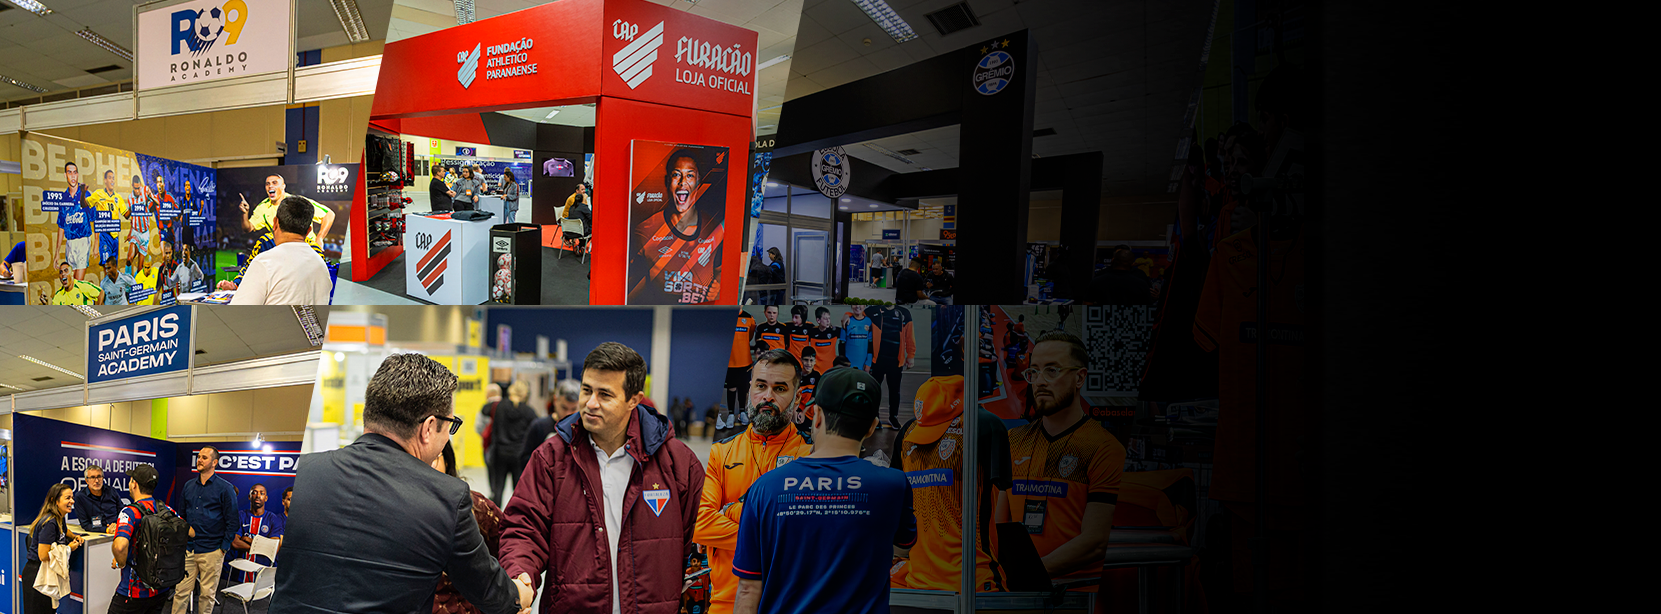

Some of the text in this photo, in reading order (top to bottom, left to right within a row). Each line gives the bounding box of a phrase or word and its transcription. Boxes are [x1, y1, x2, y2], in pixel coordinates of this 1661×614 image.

[612, 18, 639, 42] CAP
[486, 37, 533, 57] FUNDAÇÃO
[674, 35, 752, 77] FURACÃO
[170, 51, 248, 73] RONALDO
[486, 52, 528, 68] ATHLETICO
[170, 64, 247, 82] ACADEMY
[486, 63, 538, 80] PARANAENSE
[675, 68, 751, 95] LOJA OFICIAL
[975, 65, 1012, 82] GRÊMIO
[22, 139, 66, 183] BE
[47, 192, 63, 200] 1993
[816, 177, 847, 197] FUTEBOL
[415, 231, 433, 251] CAP
[98, 312, 179, 352] PARIS
[97, 337, 179, 363] SAINT-GERMAIN
[97, 350, 178, 377] ACADEMY
[60, 455, 70, 471] A
[71, 456, 112, 473] ESCOLA
[113, 460, 124, 473] DE
[783, 476, 862, 491] PARIS
[906, 473, 947, 485] RAMONTINA
